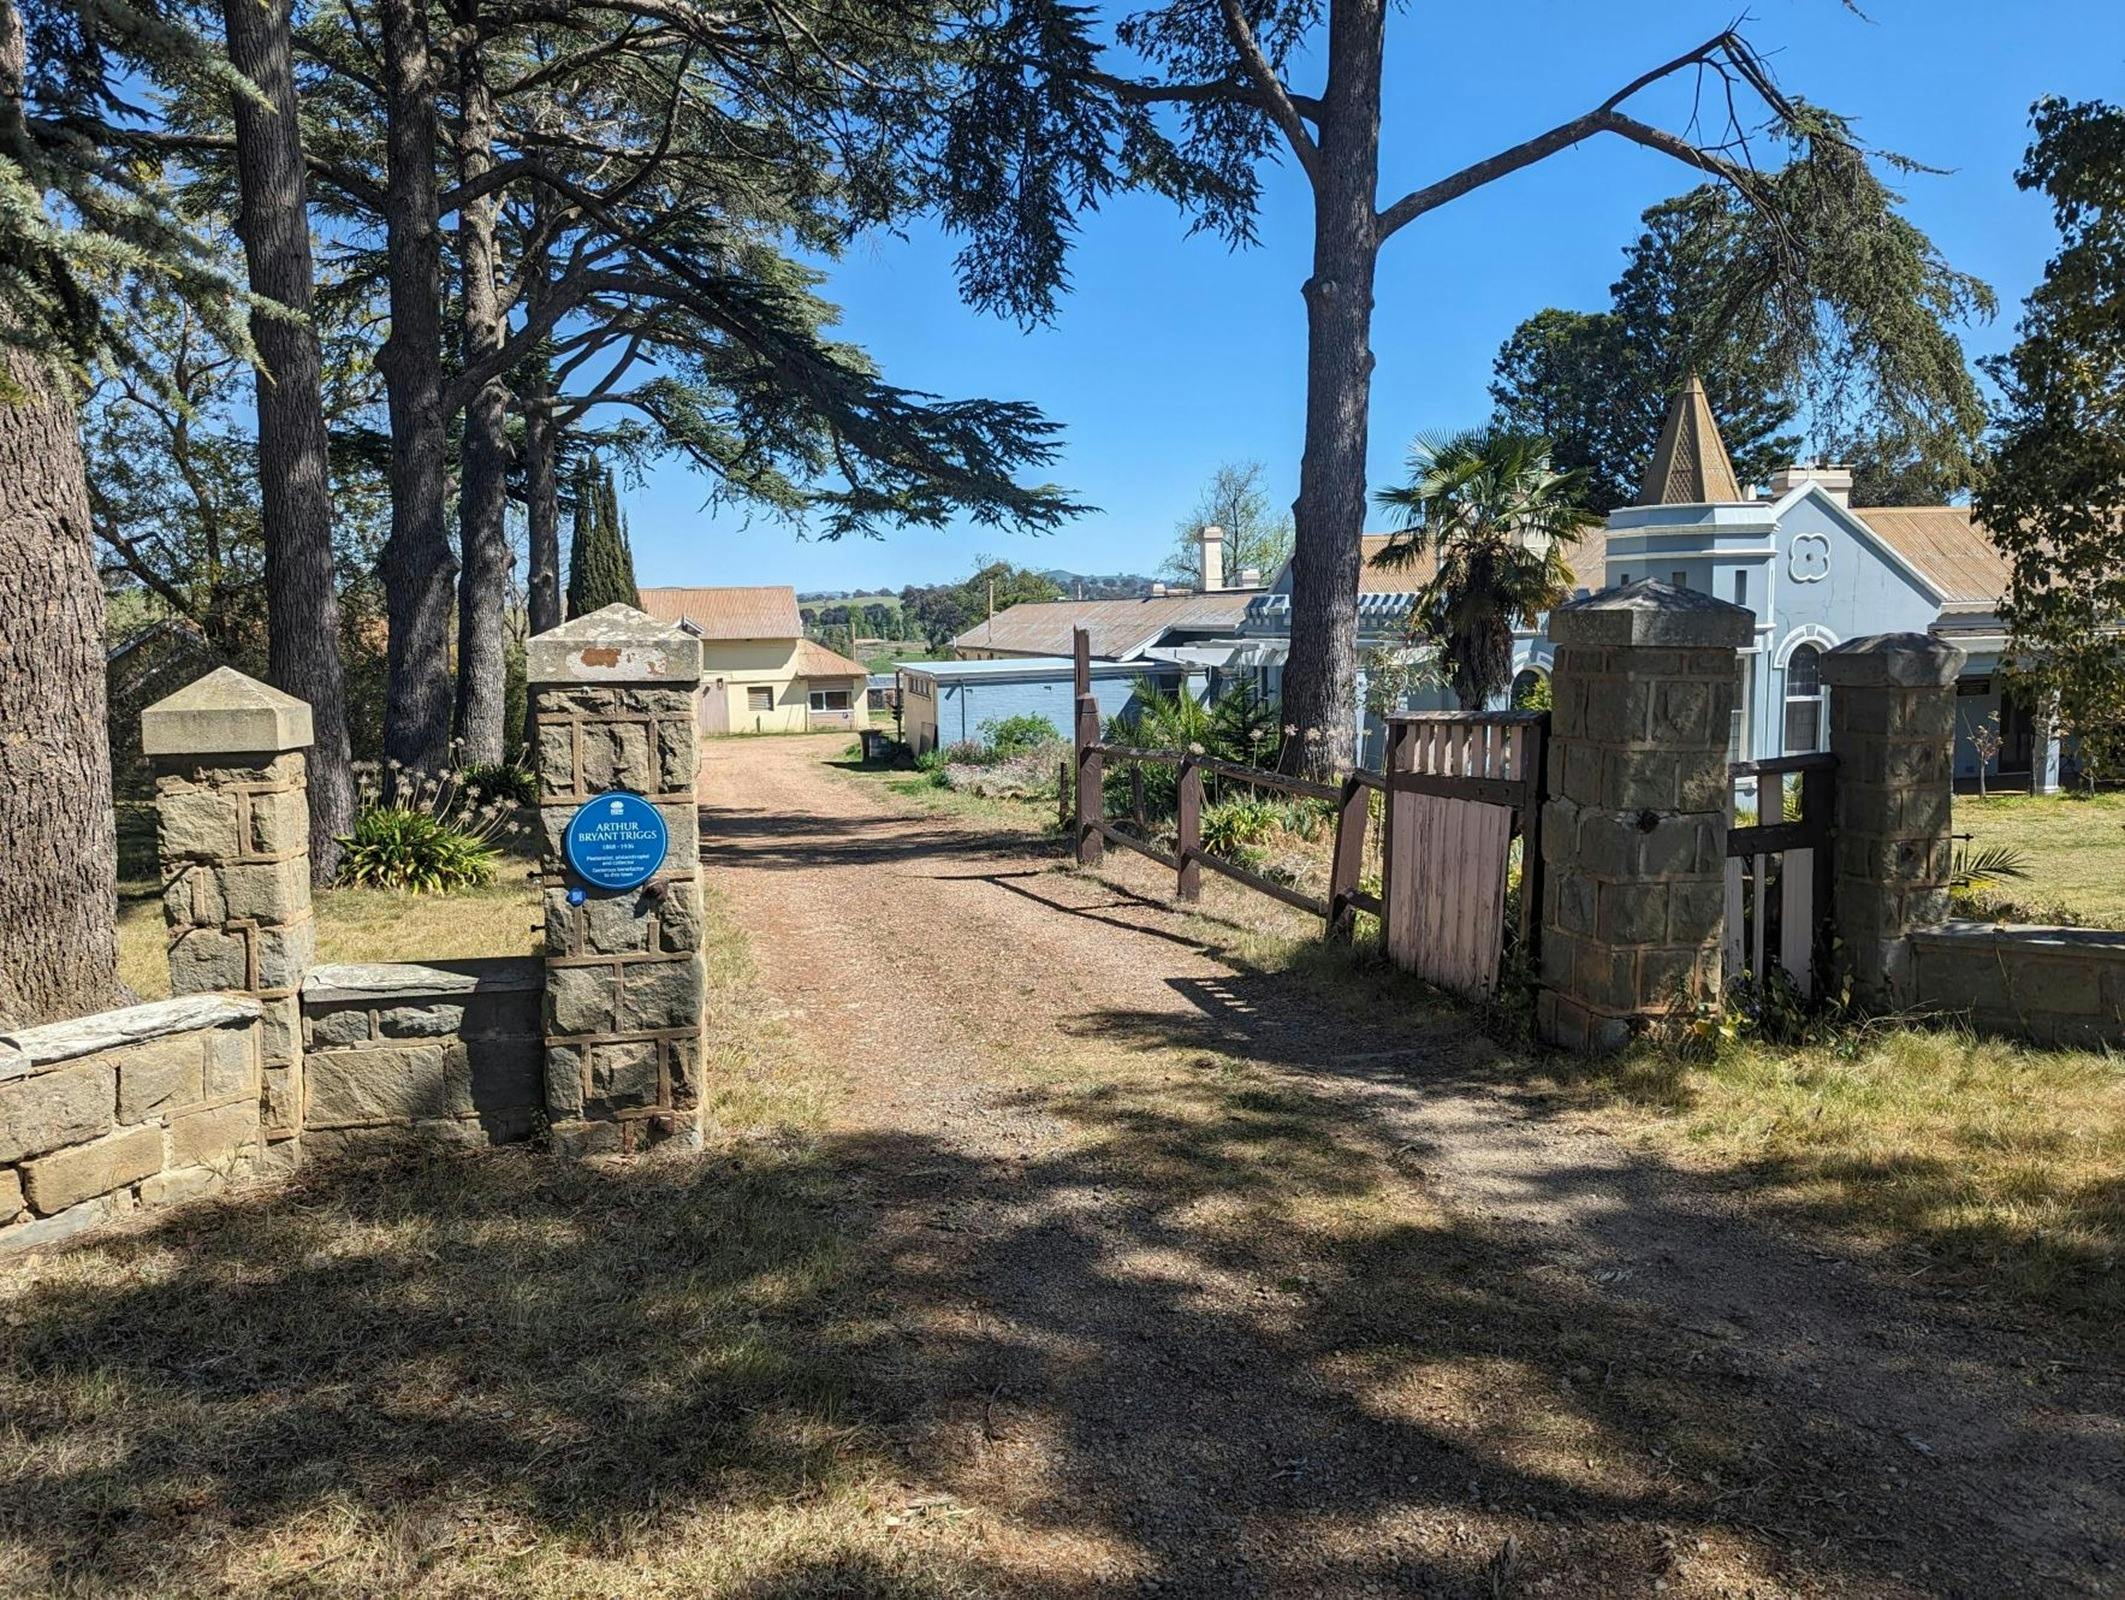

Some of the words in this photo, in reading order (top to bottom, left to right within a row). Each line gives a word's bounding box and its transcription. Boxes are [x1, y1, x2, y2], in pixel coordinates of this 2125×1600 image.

[596, 822, 639, 831] ARTHUR
[578, 832, 619, 842] BRYANT
[620, 830, 657, 840] TRIGGS
